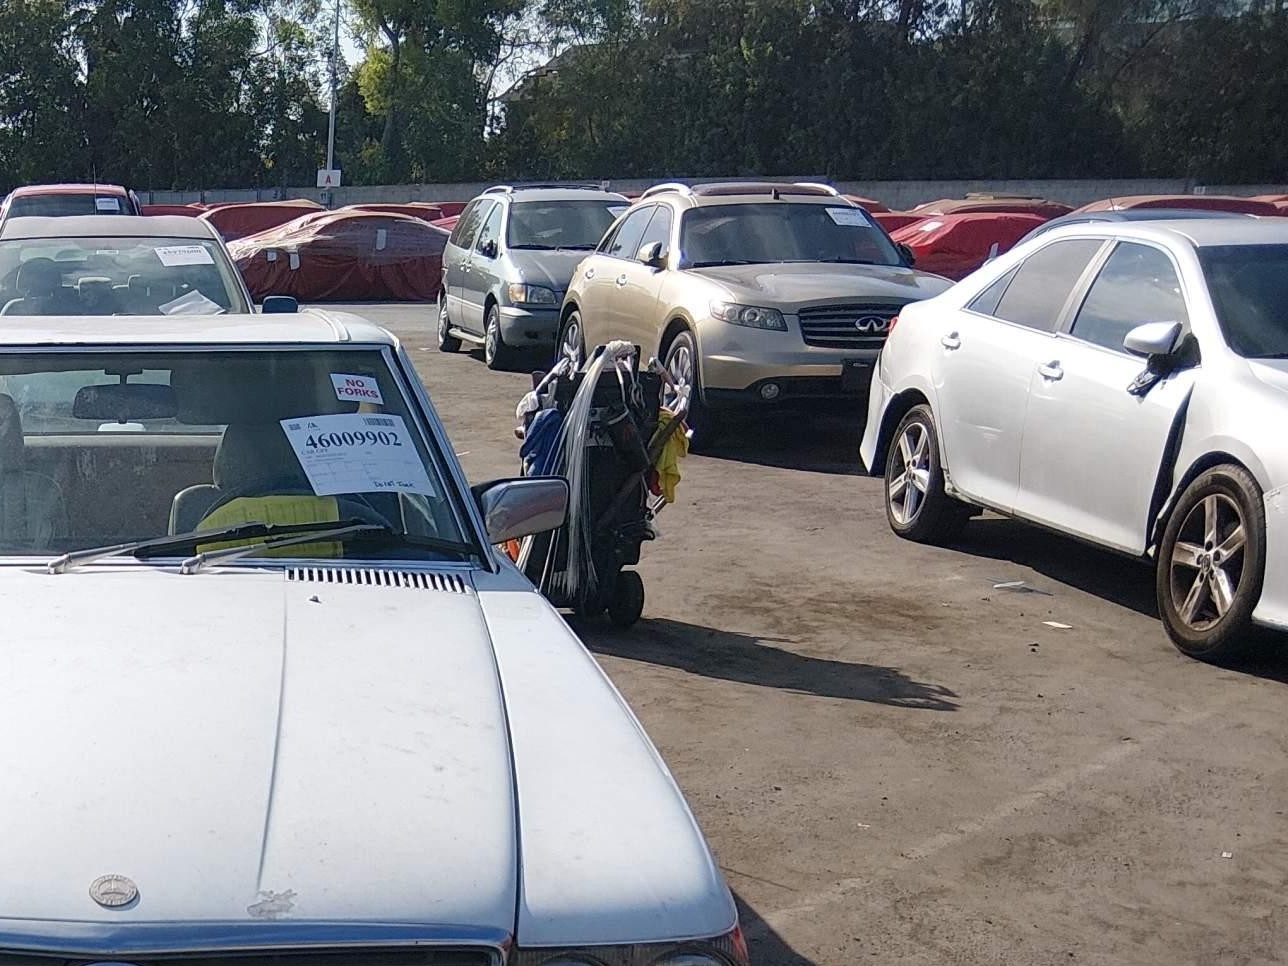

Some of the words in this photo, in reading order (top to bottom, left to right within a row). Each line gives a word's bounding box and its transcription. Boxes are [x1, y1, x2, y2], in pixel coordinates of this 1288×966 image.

[325, 174, 331, 184] A
[345, 378, 365, 387] NO
[337, 387, 379, 398] FORKS
[305, 431, 402, 449] 46009902
